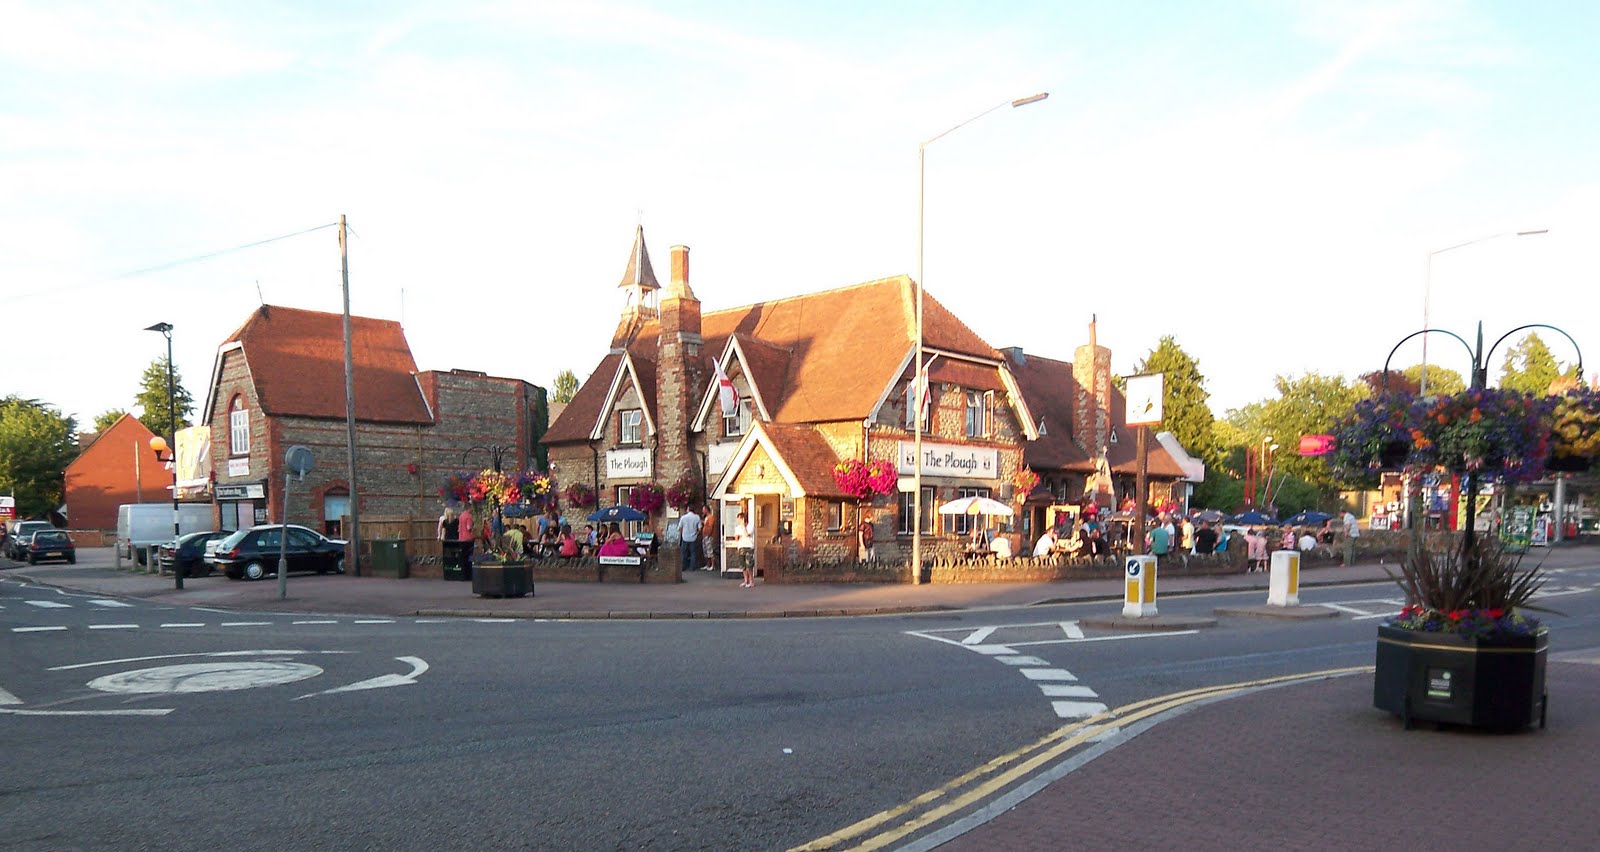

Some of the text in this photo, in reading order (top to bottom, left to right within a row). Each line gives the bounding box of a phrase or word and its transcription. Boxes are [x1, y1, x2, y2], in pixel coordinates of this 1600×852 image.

[611, 456, 648, 472] The Plough
[924, 450, 977, 474] The Plough
